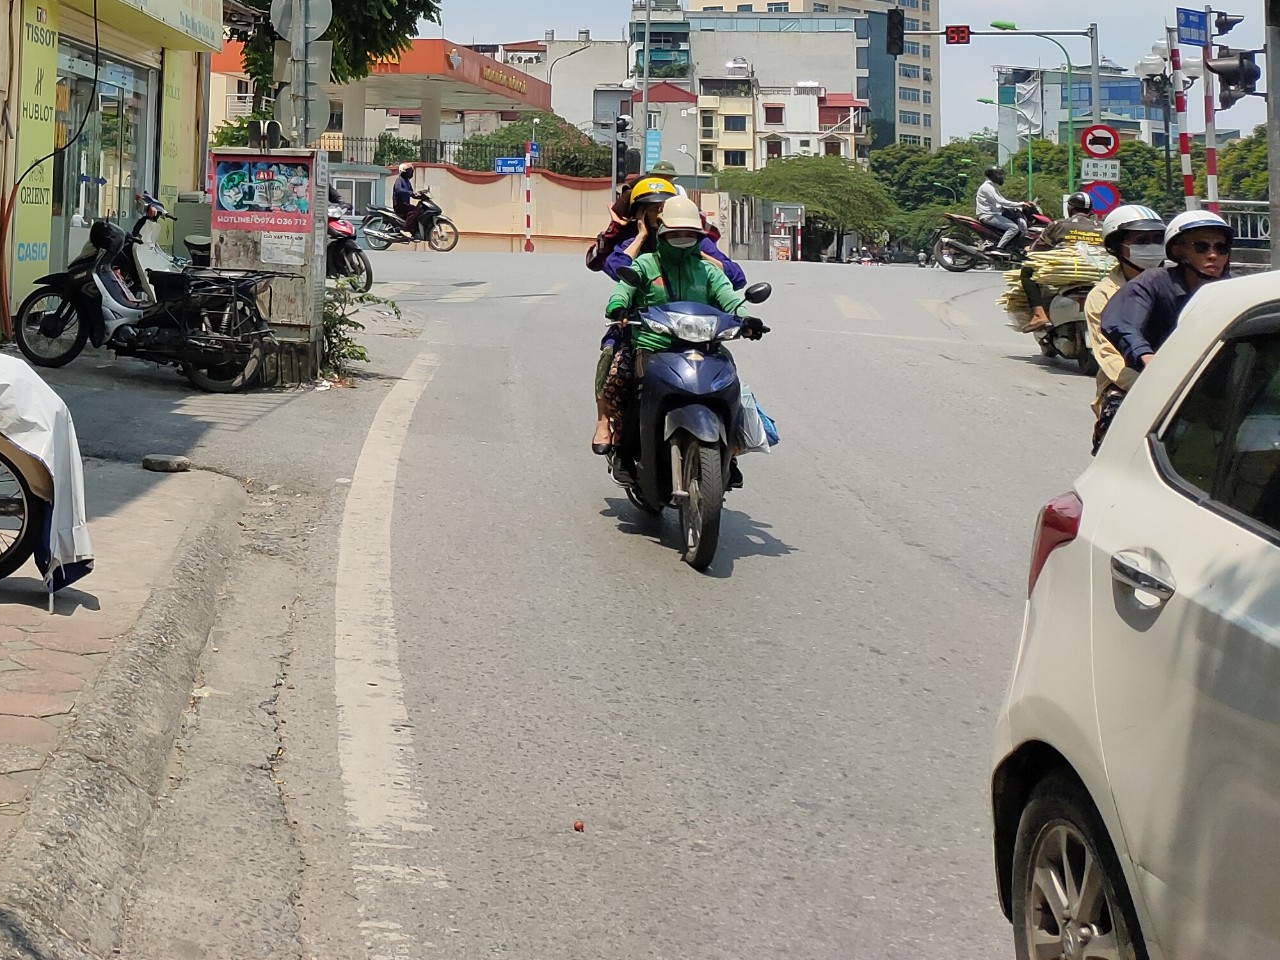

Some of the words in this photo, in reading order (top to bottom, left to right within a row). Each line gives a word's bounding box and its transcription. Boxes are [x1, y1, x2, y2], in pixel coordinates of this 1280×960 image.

[25, 23, 57, 48] TISSOT
[947, 27, 968, 43] 53
[23, 101, 54, 123] HUBLOT
[20, 186, 50, 206] ORIENT
[17, 243, 48, 262] CASIO
